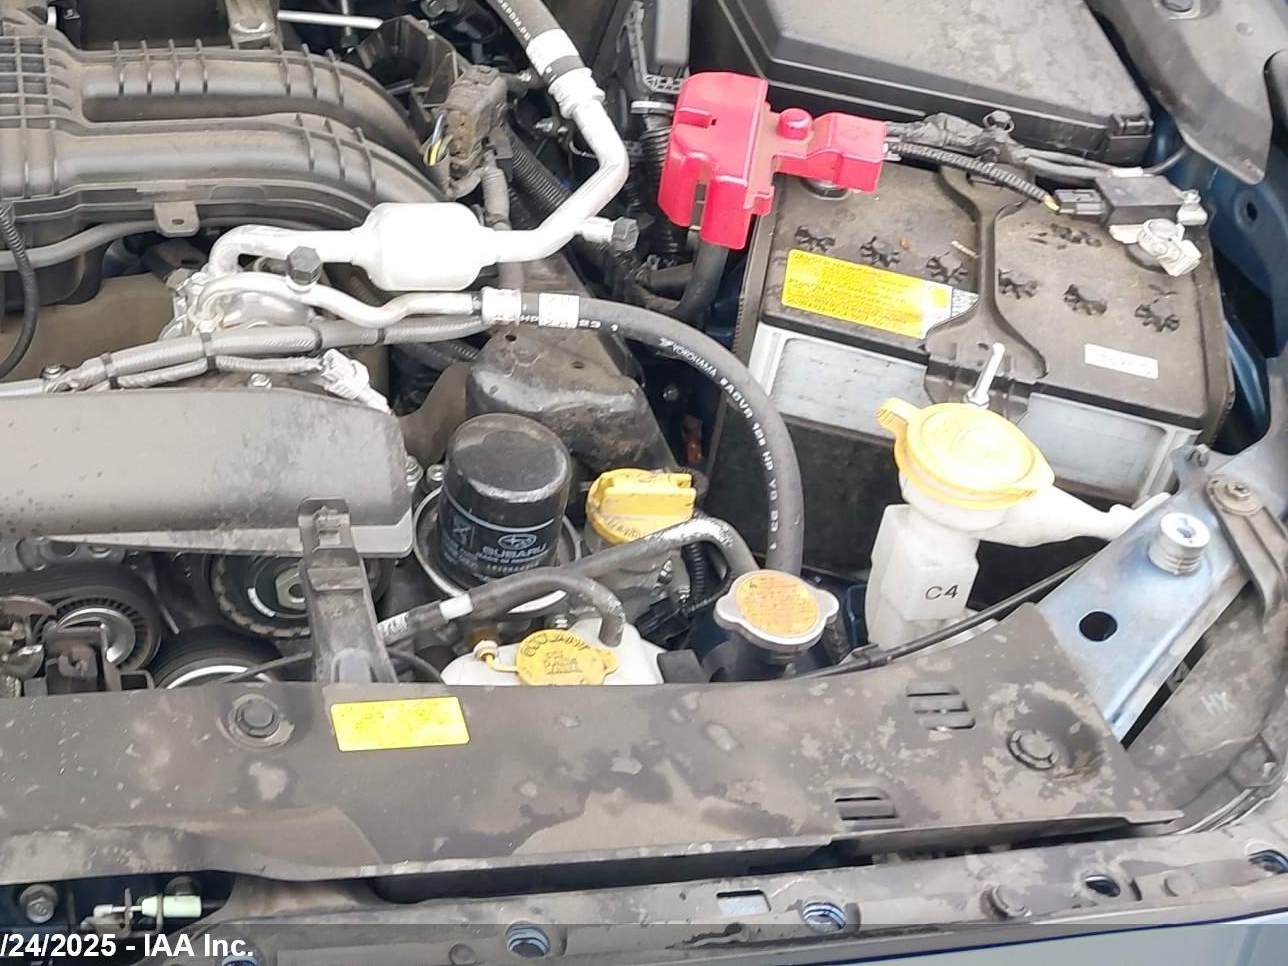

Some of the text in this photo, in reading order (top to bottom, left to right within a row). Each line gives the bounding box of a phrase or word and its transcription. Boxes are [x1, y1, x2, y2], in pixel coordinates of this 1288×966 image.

[671, 342, 718, 377] YOKOHAMA
[482, 542, 547, 560] SUBARU
[925, 584, 960, 601] C4
